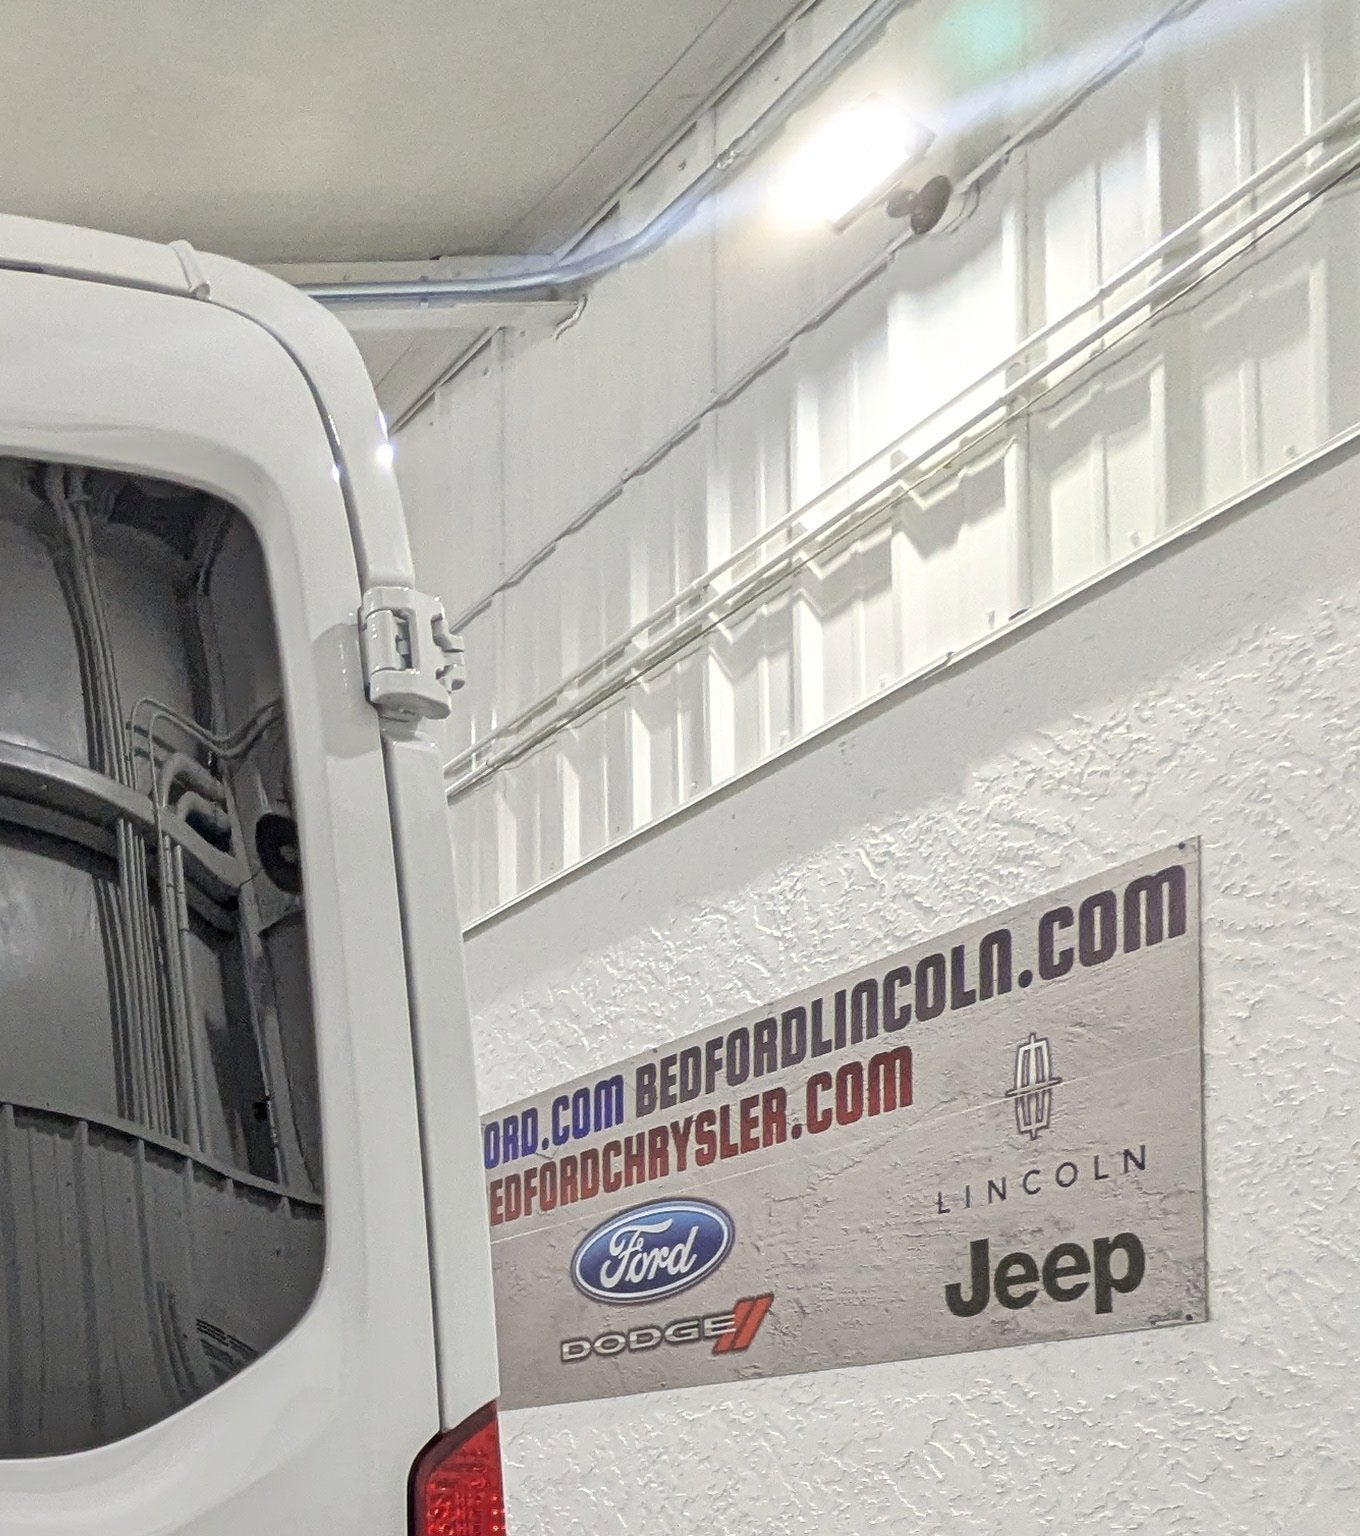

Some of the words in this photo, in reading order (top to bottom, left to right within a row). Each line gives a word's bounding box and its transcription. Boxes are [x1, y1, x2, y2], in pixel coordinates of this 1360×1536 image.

[483, 1074, 624, 1169] ORD.COM
[635, 864, 1187, 1118] BEDFORDLINCOLN.COM
[489, 1045, 913, 1226] EDFORDCHRYSLER.COM
[936, 1145, 1146, 1214] LINCOLN
[600, 1218, 698, 1288] Ford
[944, 1231, 1145, 1317] Jeep
[561, 1314, 736, 1361] DODGE
